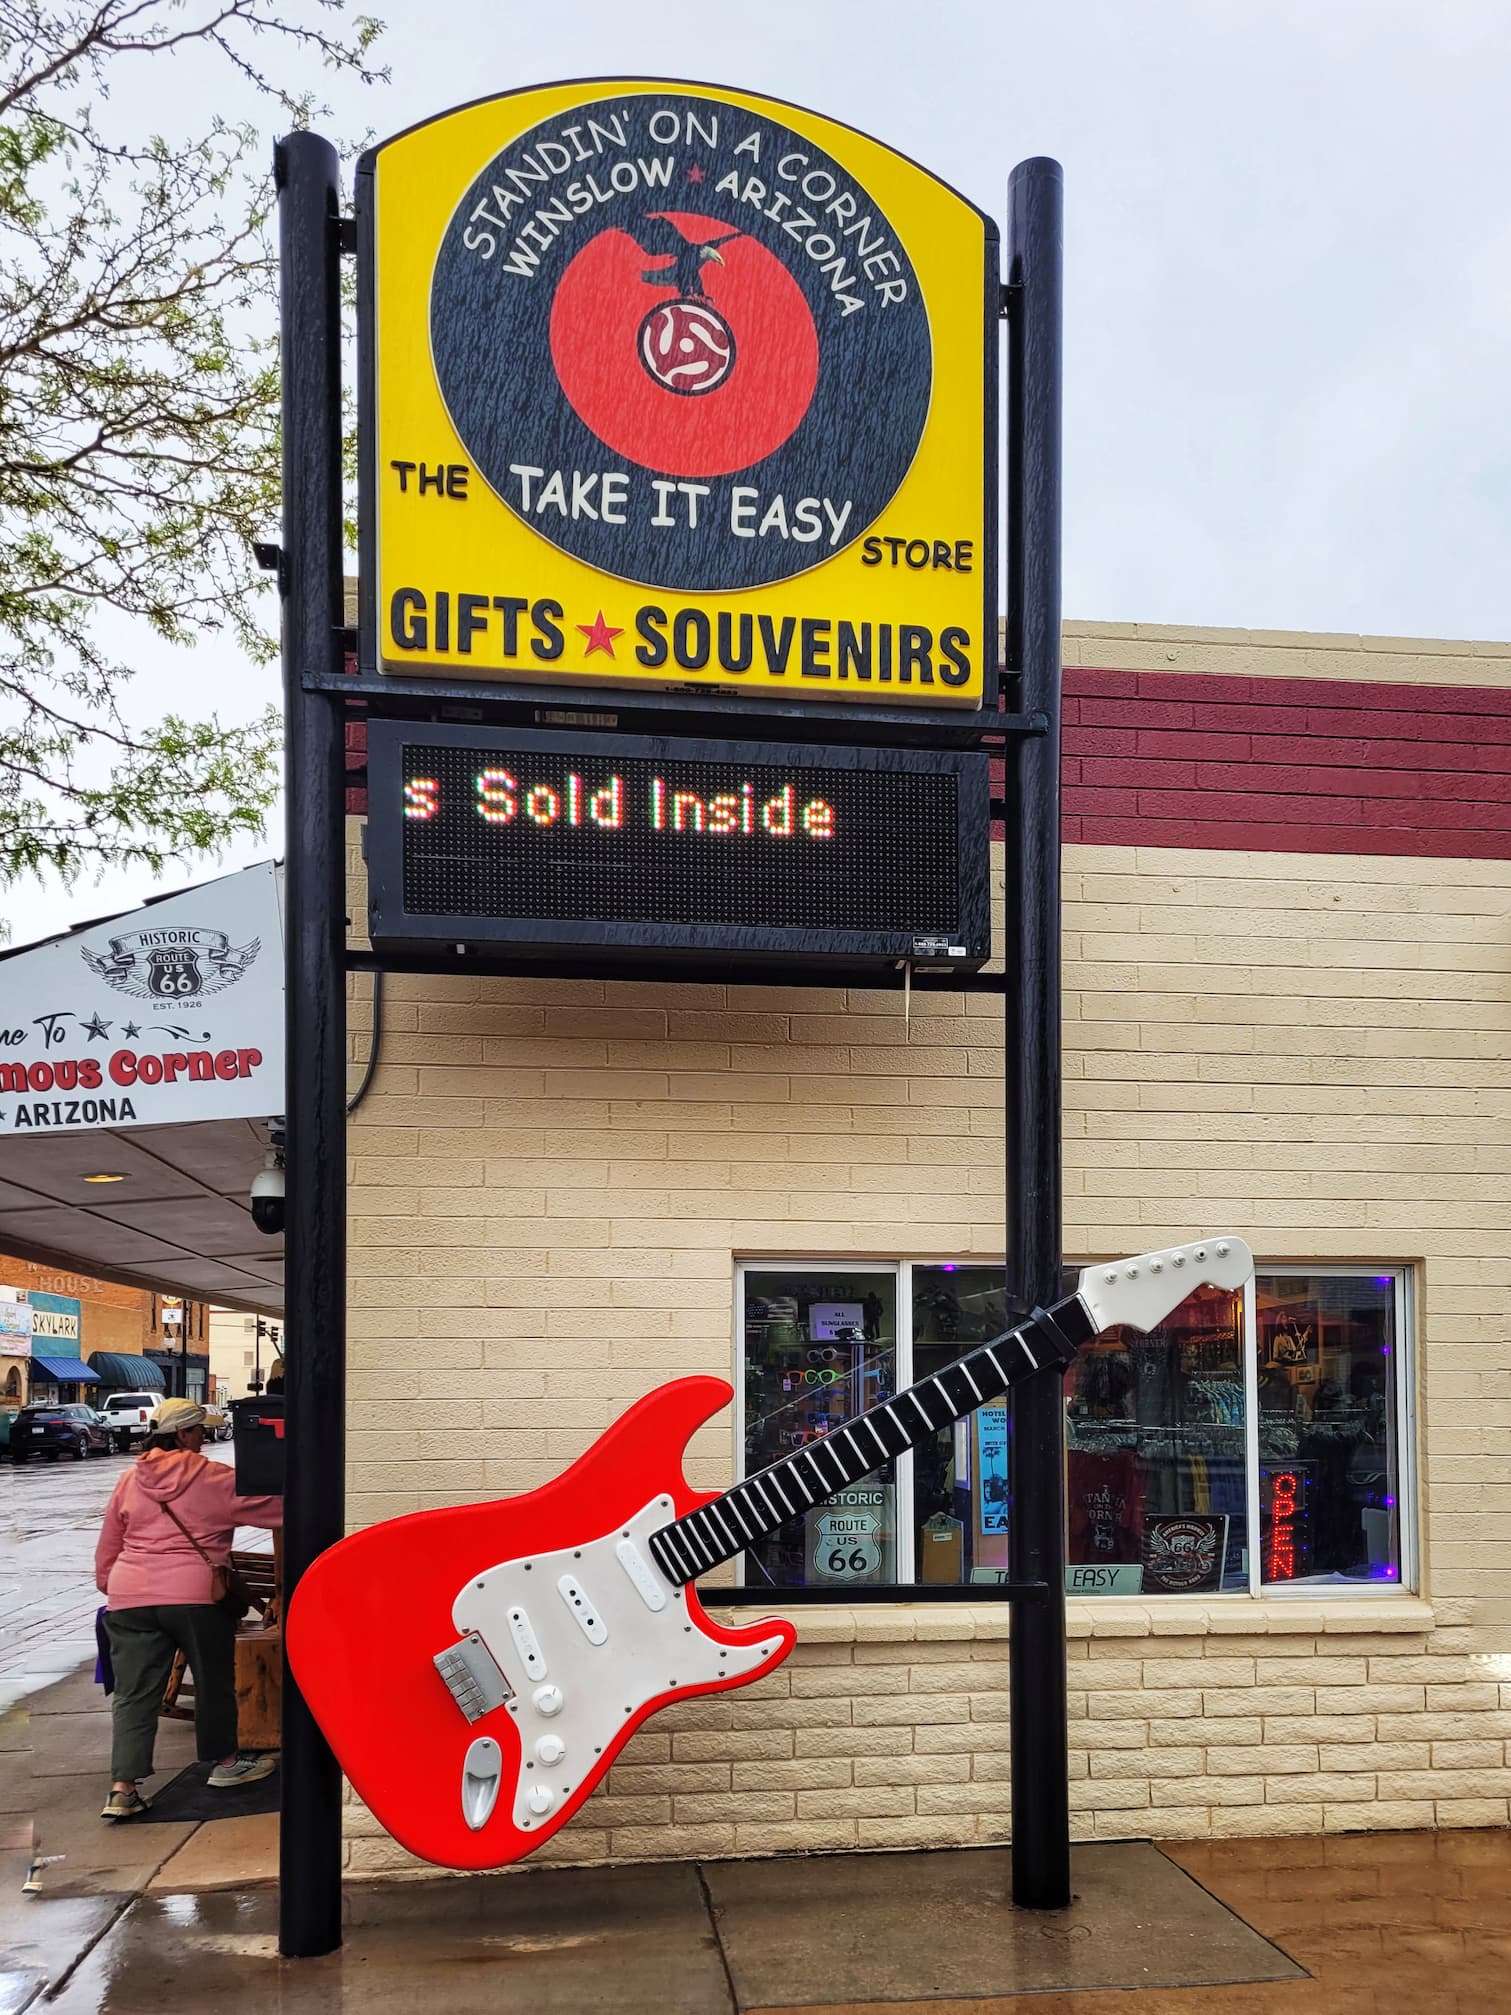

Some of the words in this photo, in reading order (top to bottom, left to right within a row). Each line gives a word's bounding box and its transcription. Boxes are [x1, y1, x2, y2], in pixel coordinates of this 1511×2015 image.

[463, 110, 630, 260] STANDIN'
[648, 110, 719, 149] ON
[734, 131, 761, 164] A
[776, 154, 908, 308] CORNER
[503, 157, 675, 278] WINSLOW
[715, 169, 865, 317] ARIZONA
[391, 461, 469, 499] THE
[509, 463, 629, 524] TAKE
[651, 480, 710, 529] IT
[730, 486, 852, 545] EASY
[861, 536, 974, 572] STORE
[390, 587, 565, 660] GIFTS
[634, 605, 971, 684] SOUVENIRS
[404, 778, 439, 818] s
[477, 769, 623, 829] Sold
[652, 777, 835, 839] Inside
[139, 931, 200, 946] HISTORIC
[155, 953, 190, 963] ROUTE
[163, 965, 184, 973] US
[159, 975, 192, 992] 66
[153, 1002, 175, 1010] EST.
[177, 1000, 202, 1009] 1926
[32, 1012, 76, 1049] To
[0, 1058, 103, 1093] mous
[108, 1047, 263, 1087] Corner
[14, 1097, 137, 1128] ARIZONA
[33, 1314, 77, 1335] SKYLARK
[830, 1520, 867, 1531] ROUTE
[837, 1537, 858, 1545] US
[1273, 1474, 1297, 1578] OPEN
[828, 1548, 867, 1571] 66
[1073, 1569, 1120, 1587] EASY
